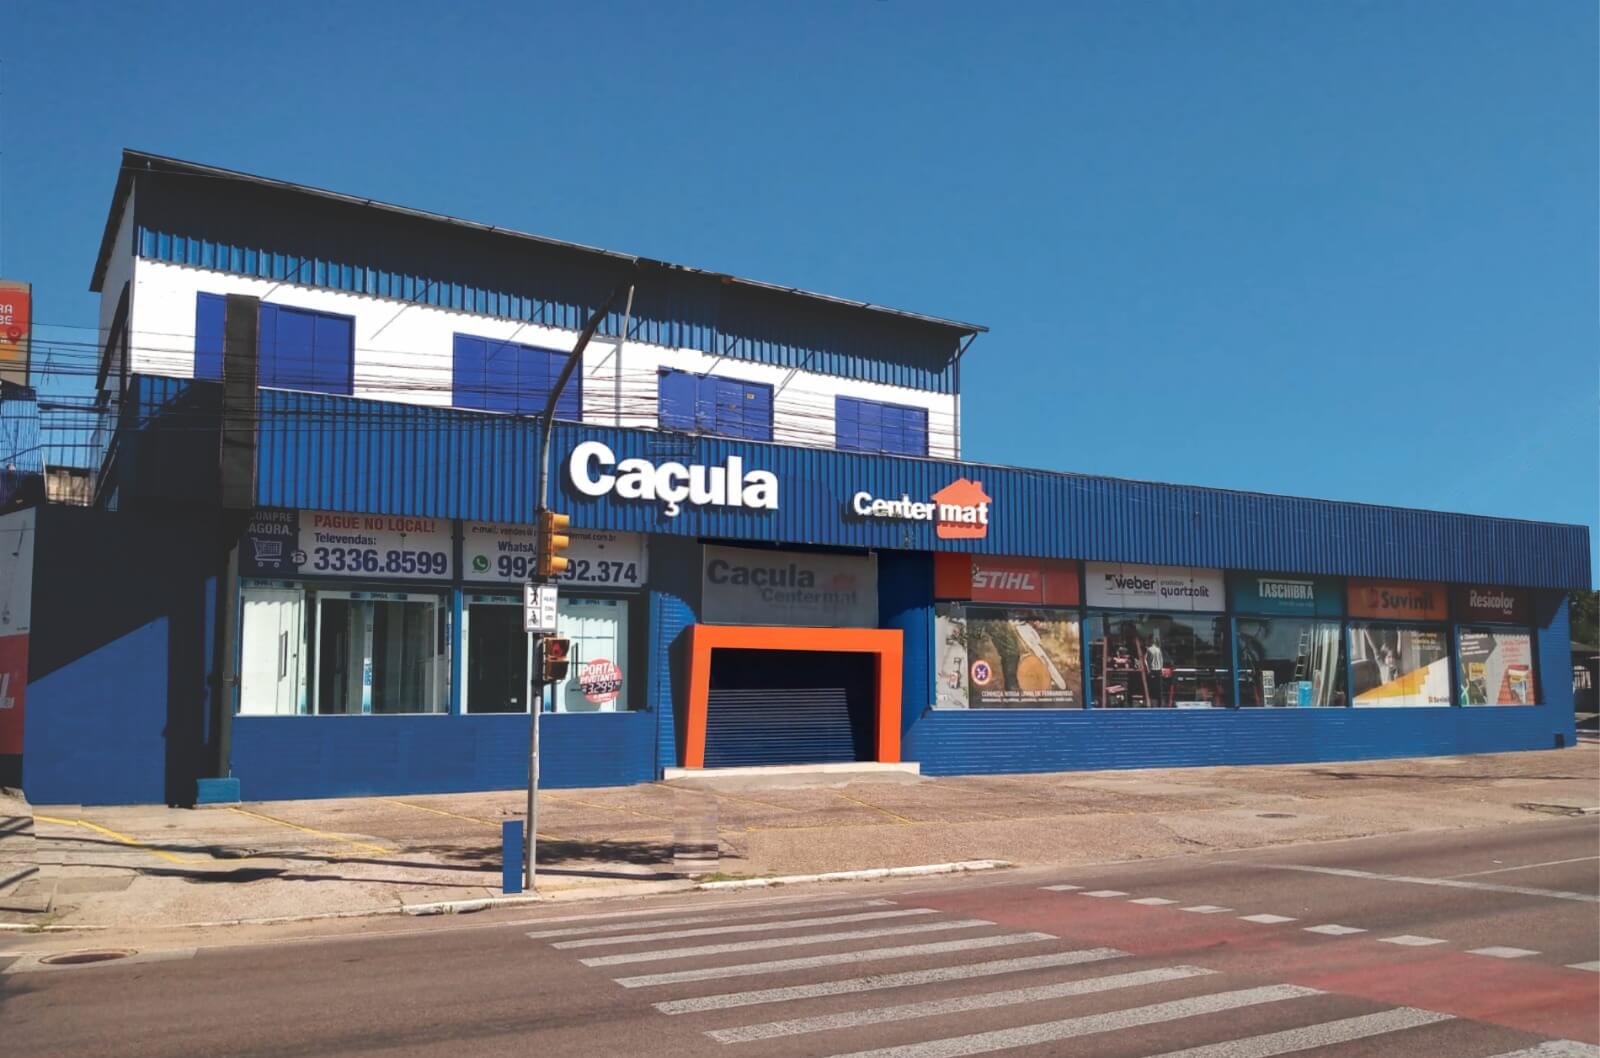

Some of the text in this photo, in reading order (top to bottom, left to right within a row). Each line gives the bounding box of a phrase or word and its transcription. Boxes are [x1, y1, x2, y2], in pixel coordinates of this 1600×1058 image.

[569, 441, 778, 516] Caçula
[250, 511, 294, 523] OMPRE
[854, 491, 988, 524] Center mat
[314, 515, 435, 532] PAGUE NO LOCAL!
[314, 533, 377, 545] Televendas:
[498, 540, 537, 553] WhatsA
[313, 547, 447, 575] 3336.8599
[972, 571, 1035, 591] STIHL
[1115, 576, 1156, 590] weber
[1161, 585, 1209, 598] quartzolit
[1258, 579, 1314, 600] TASCHIBRA
[1381, 591, 1434, 611] Suvinil
[1470, 590, 1515, 609] Resicolor
[582, 662, 615, 676] PORTA
